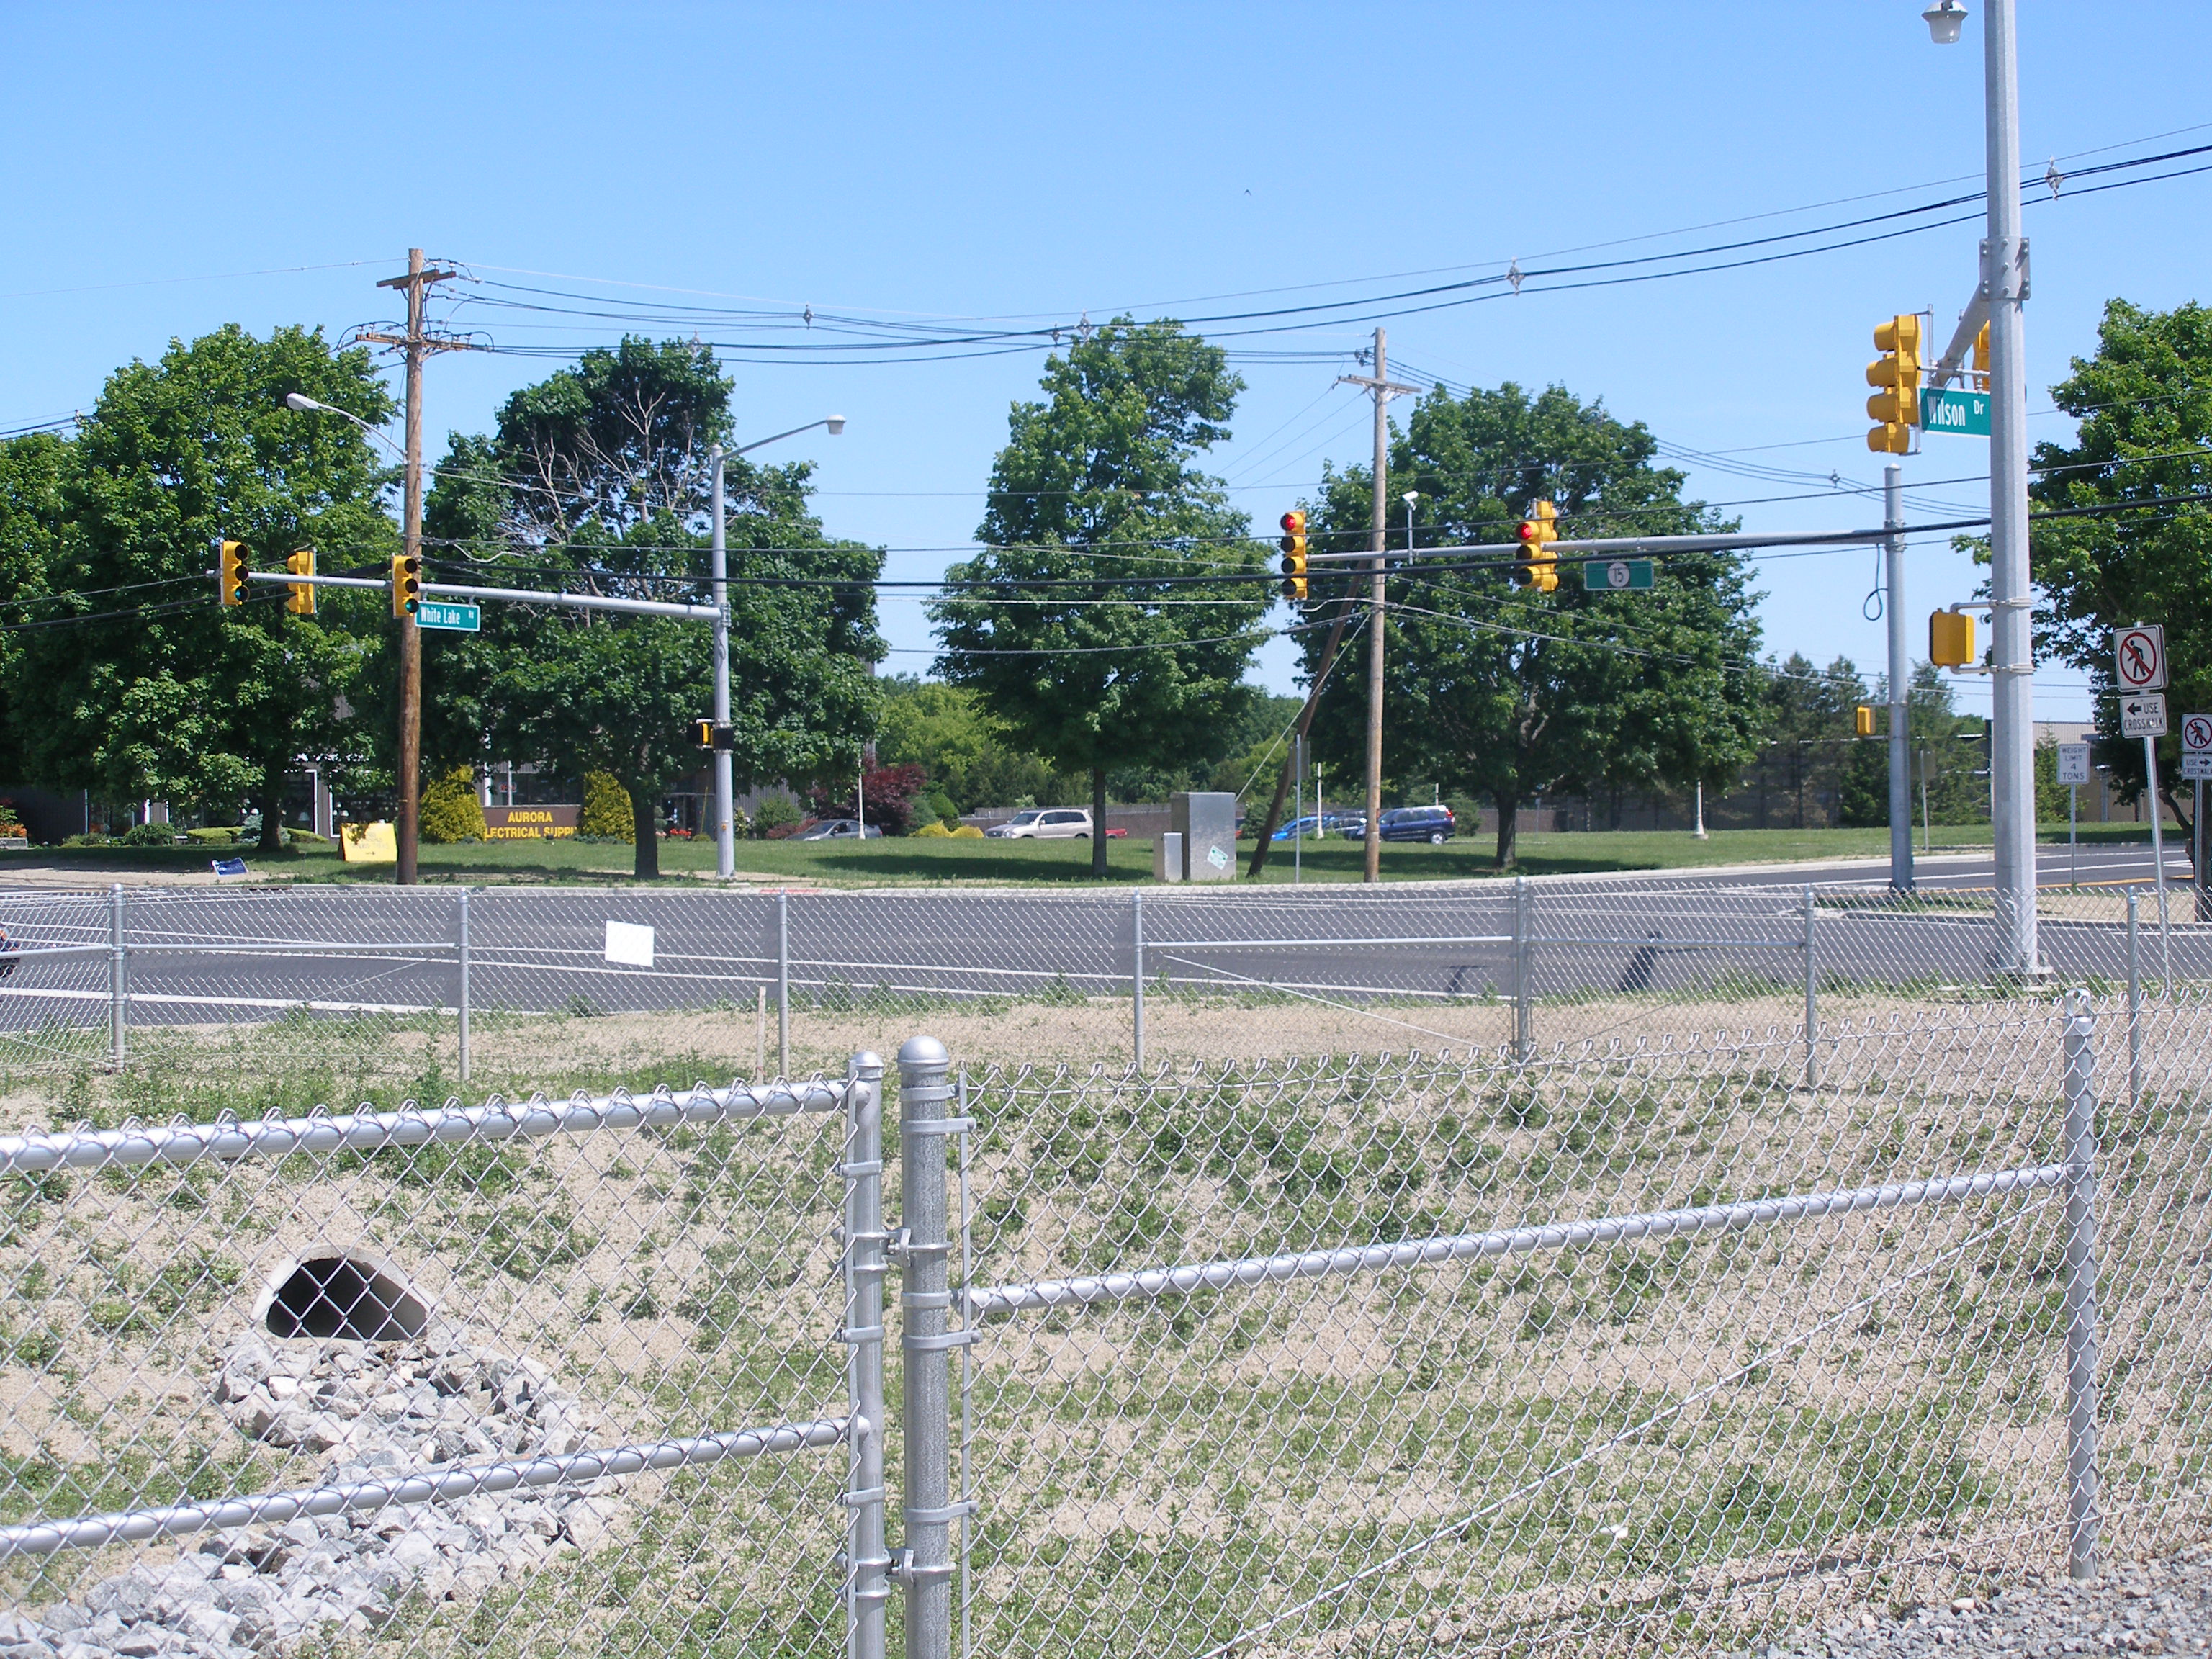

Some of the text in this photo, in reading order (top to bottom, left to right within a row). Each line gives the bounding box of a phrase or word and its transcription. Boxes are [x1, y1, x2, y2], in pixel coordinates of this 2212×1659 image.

[1927, 395, 1985, 427] Wilson Dr
[1612, 567, 1624, 583] 15
[421, 606, 441, 624] White
[443, 608, 461, 625] Lake
[2143, 701, 2159, 714] USE
[2124, 717, 2164, 731] CROSSWALK
[2062, 772, 2085, 781] TONS
[507, 811, 553, 823] AURORA
[484, 826, 577, 839] LECTRICAL SUPPL
